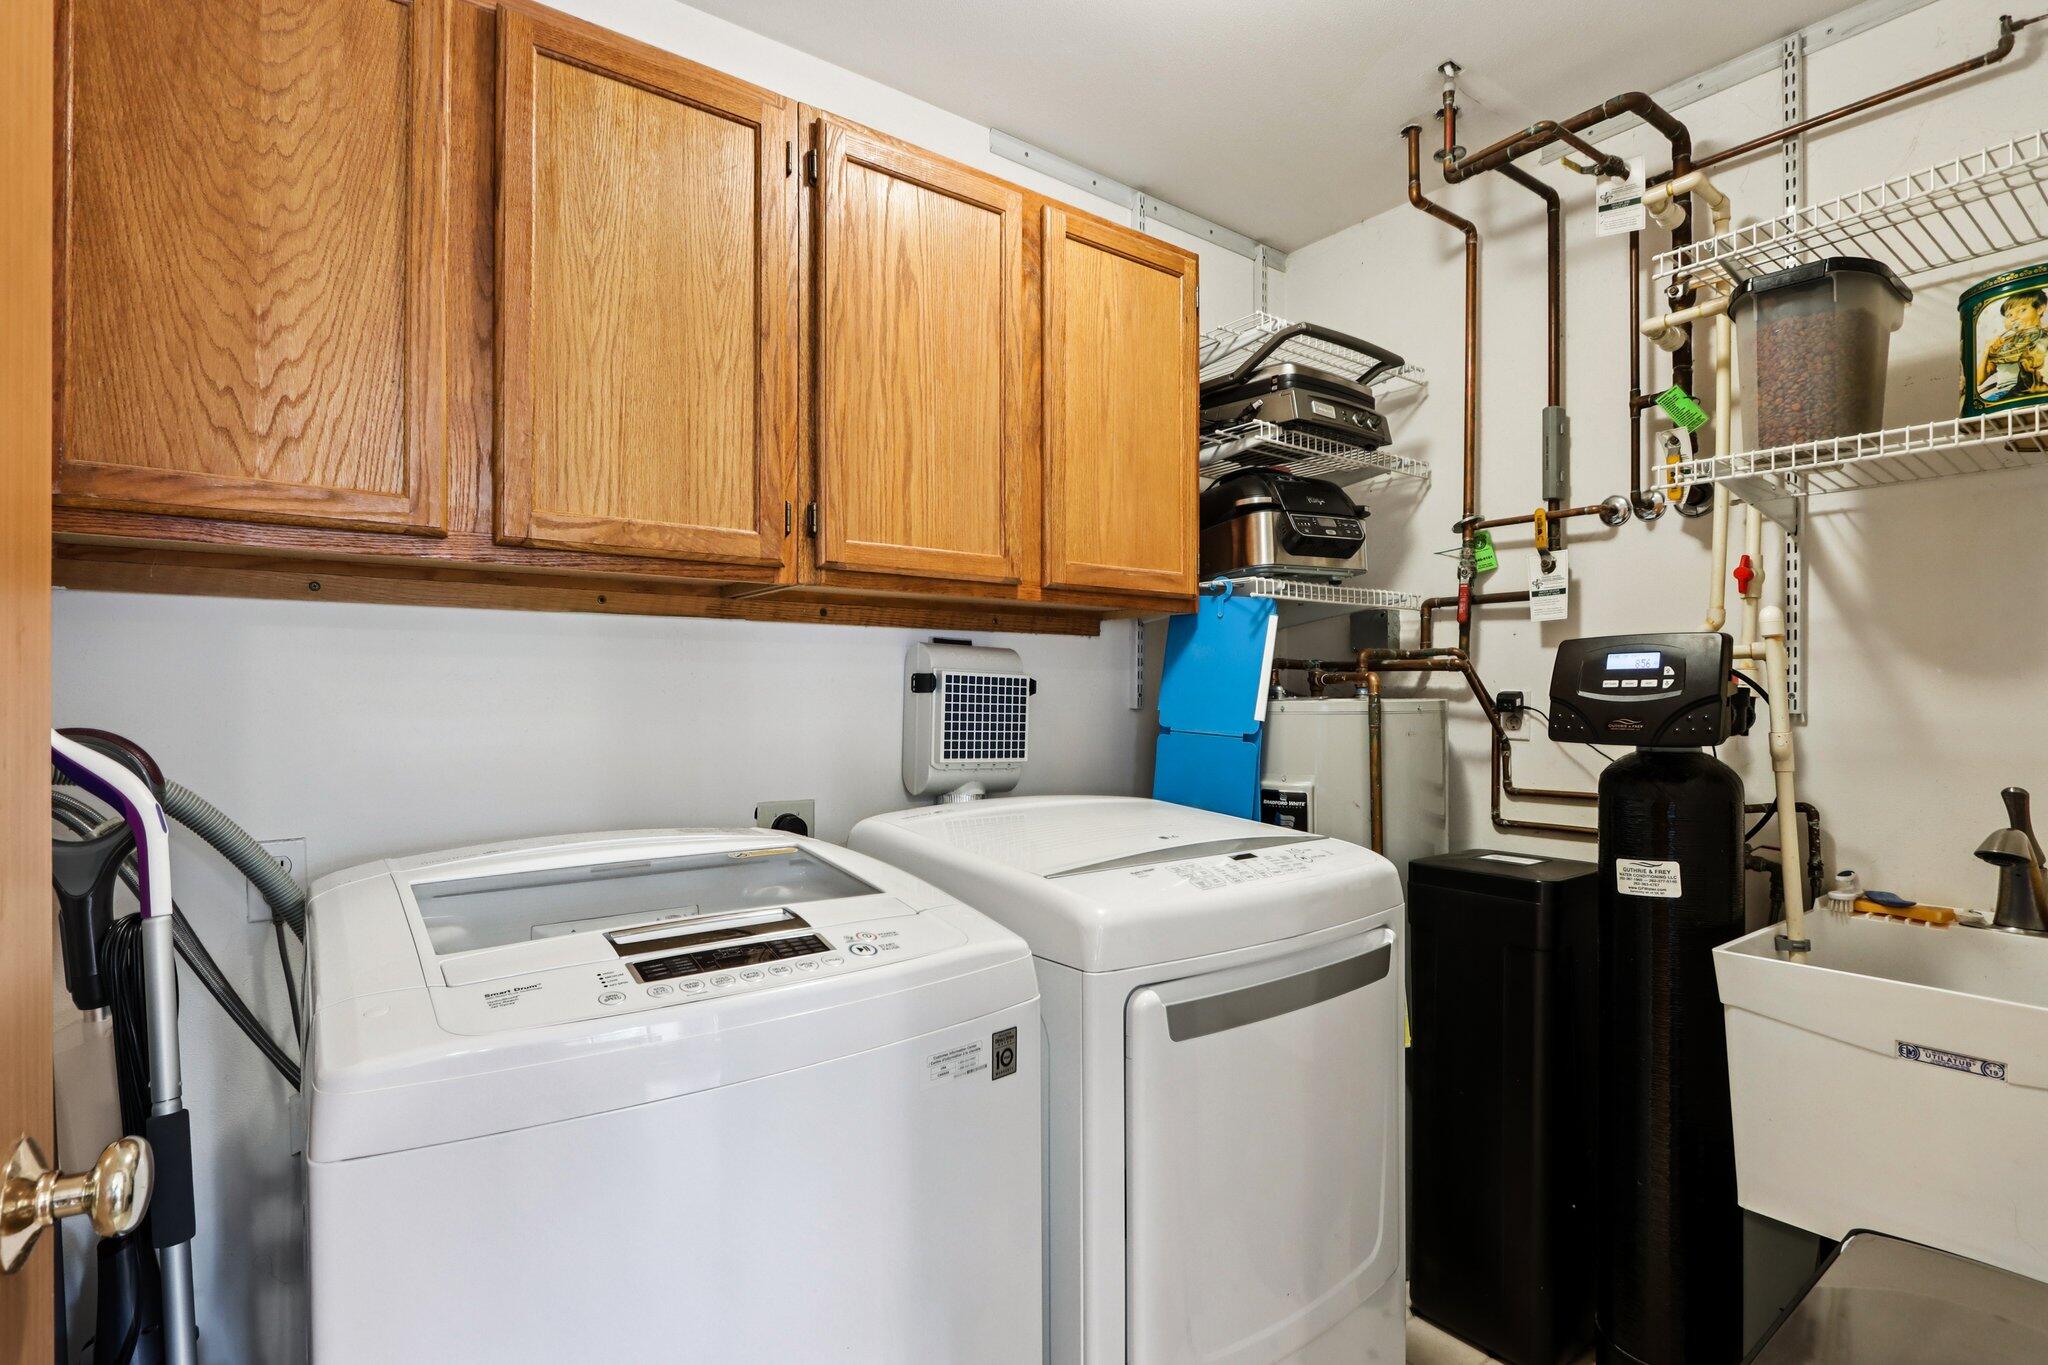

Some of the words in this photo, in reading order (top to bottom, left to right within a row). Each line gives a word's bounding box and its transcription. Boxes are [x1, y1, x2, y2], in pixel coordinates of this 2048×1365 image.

[484, 989, 511, 998] Smart
[996, 1047, 1014, 1071] 10
[1988, 1069, 1999, 1077] 19
